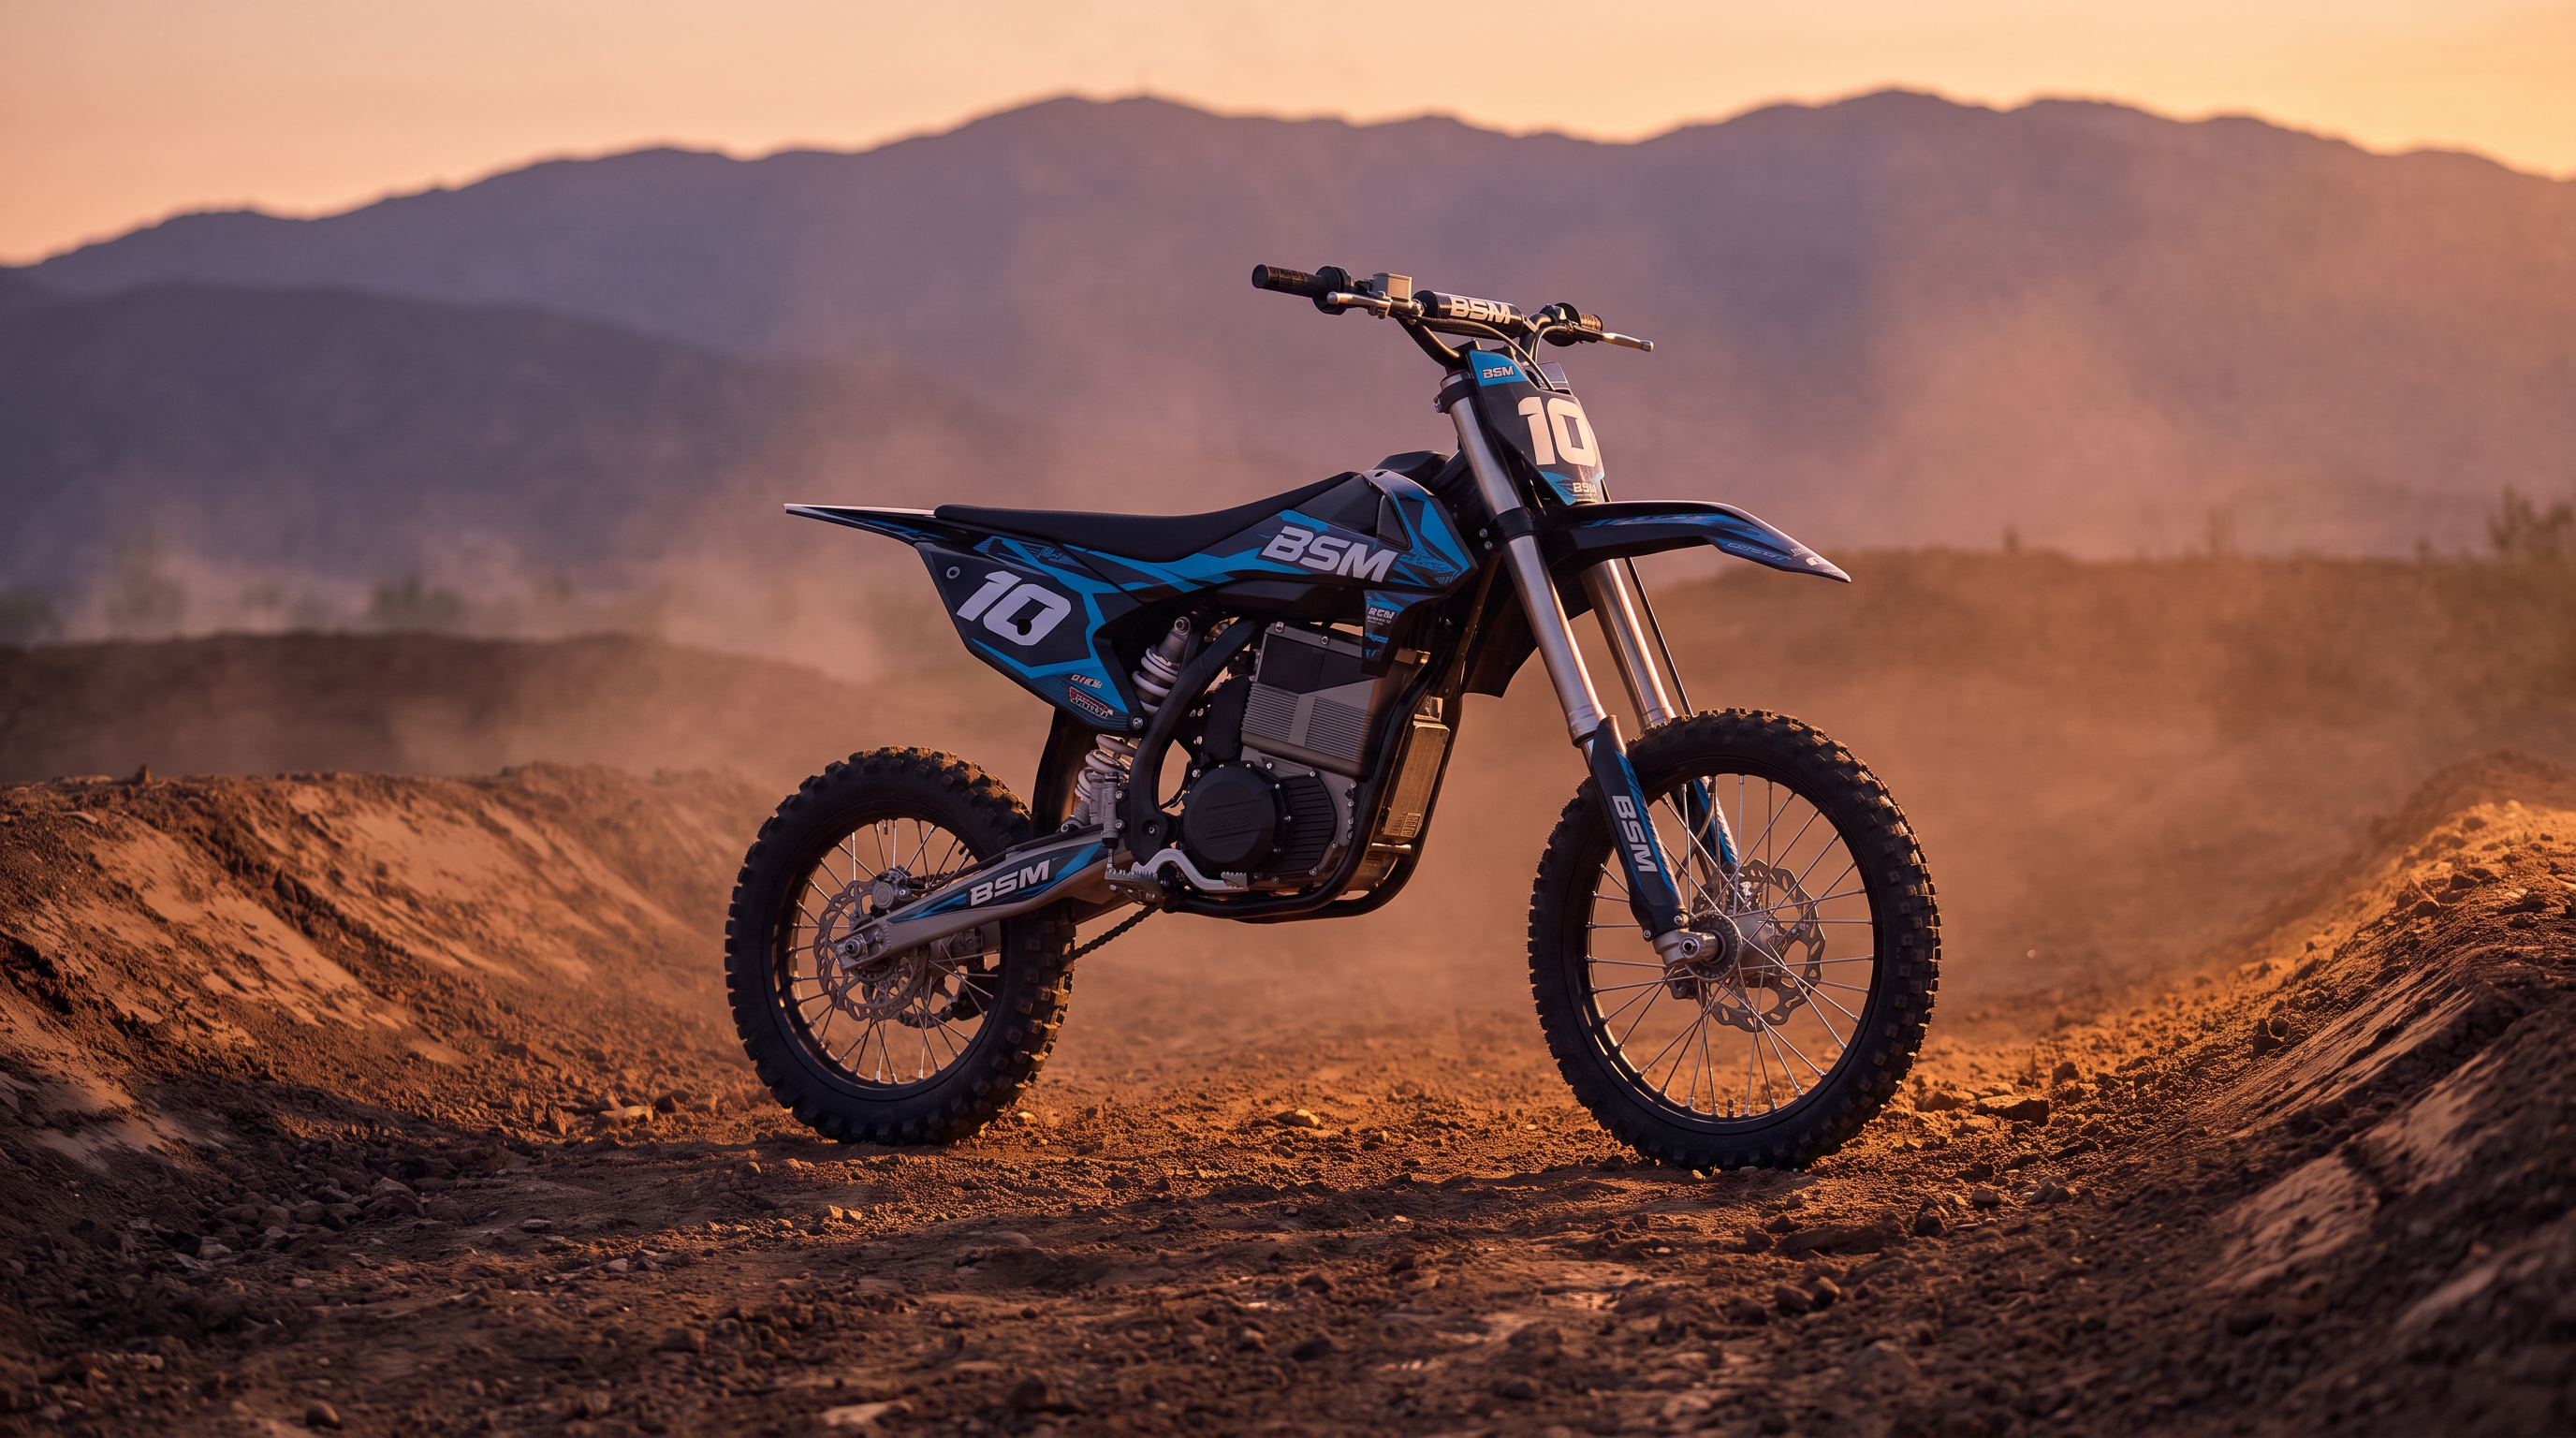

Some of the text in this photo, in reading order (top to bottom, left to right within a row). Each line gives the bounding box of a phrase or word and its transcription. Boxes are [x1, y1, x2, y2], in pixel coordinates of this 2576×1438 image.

[1449, 296, 1511, 325] BSM
[1483, 366, 1515, 379] BSM
[1517, 396, 1597, 468] 10
[1261, 525, 1398, 583] BSM
[956, 570, 1072, 647] 10
[1612, 795, 1659, 873] BSM
[970, 859, 1050, 906] BSM
